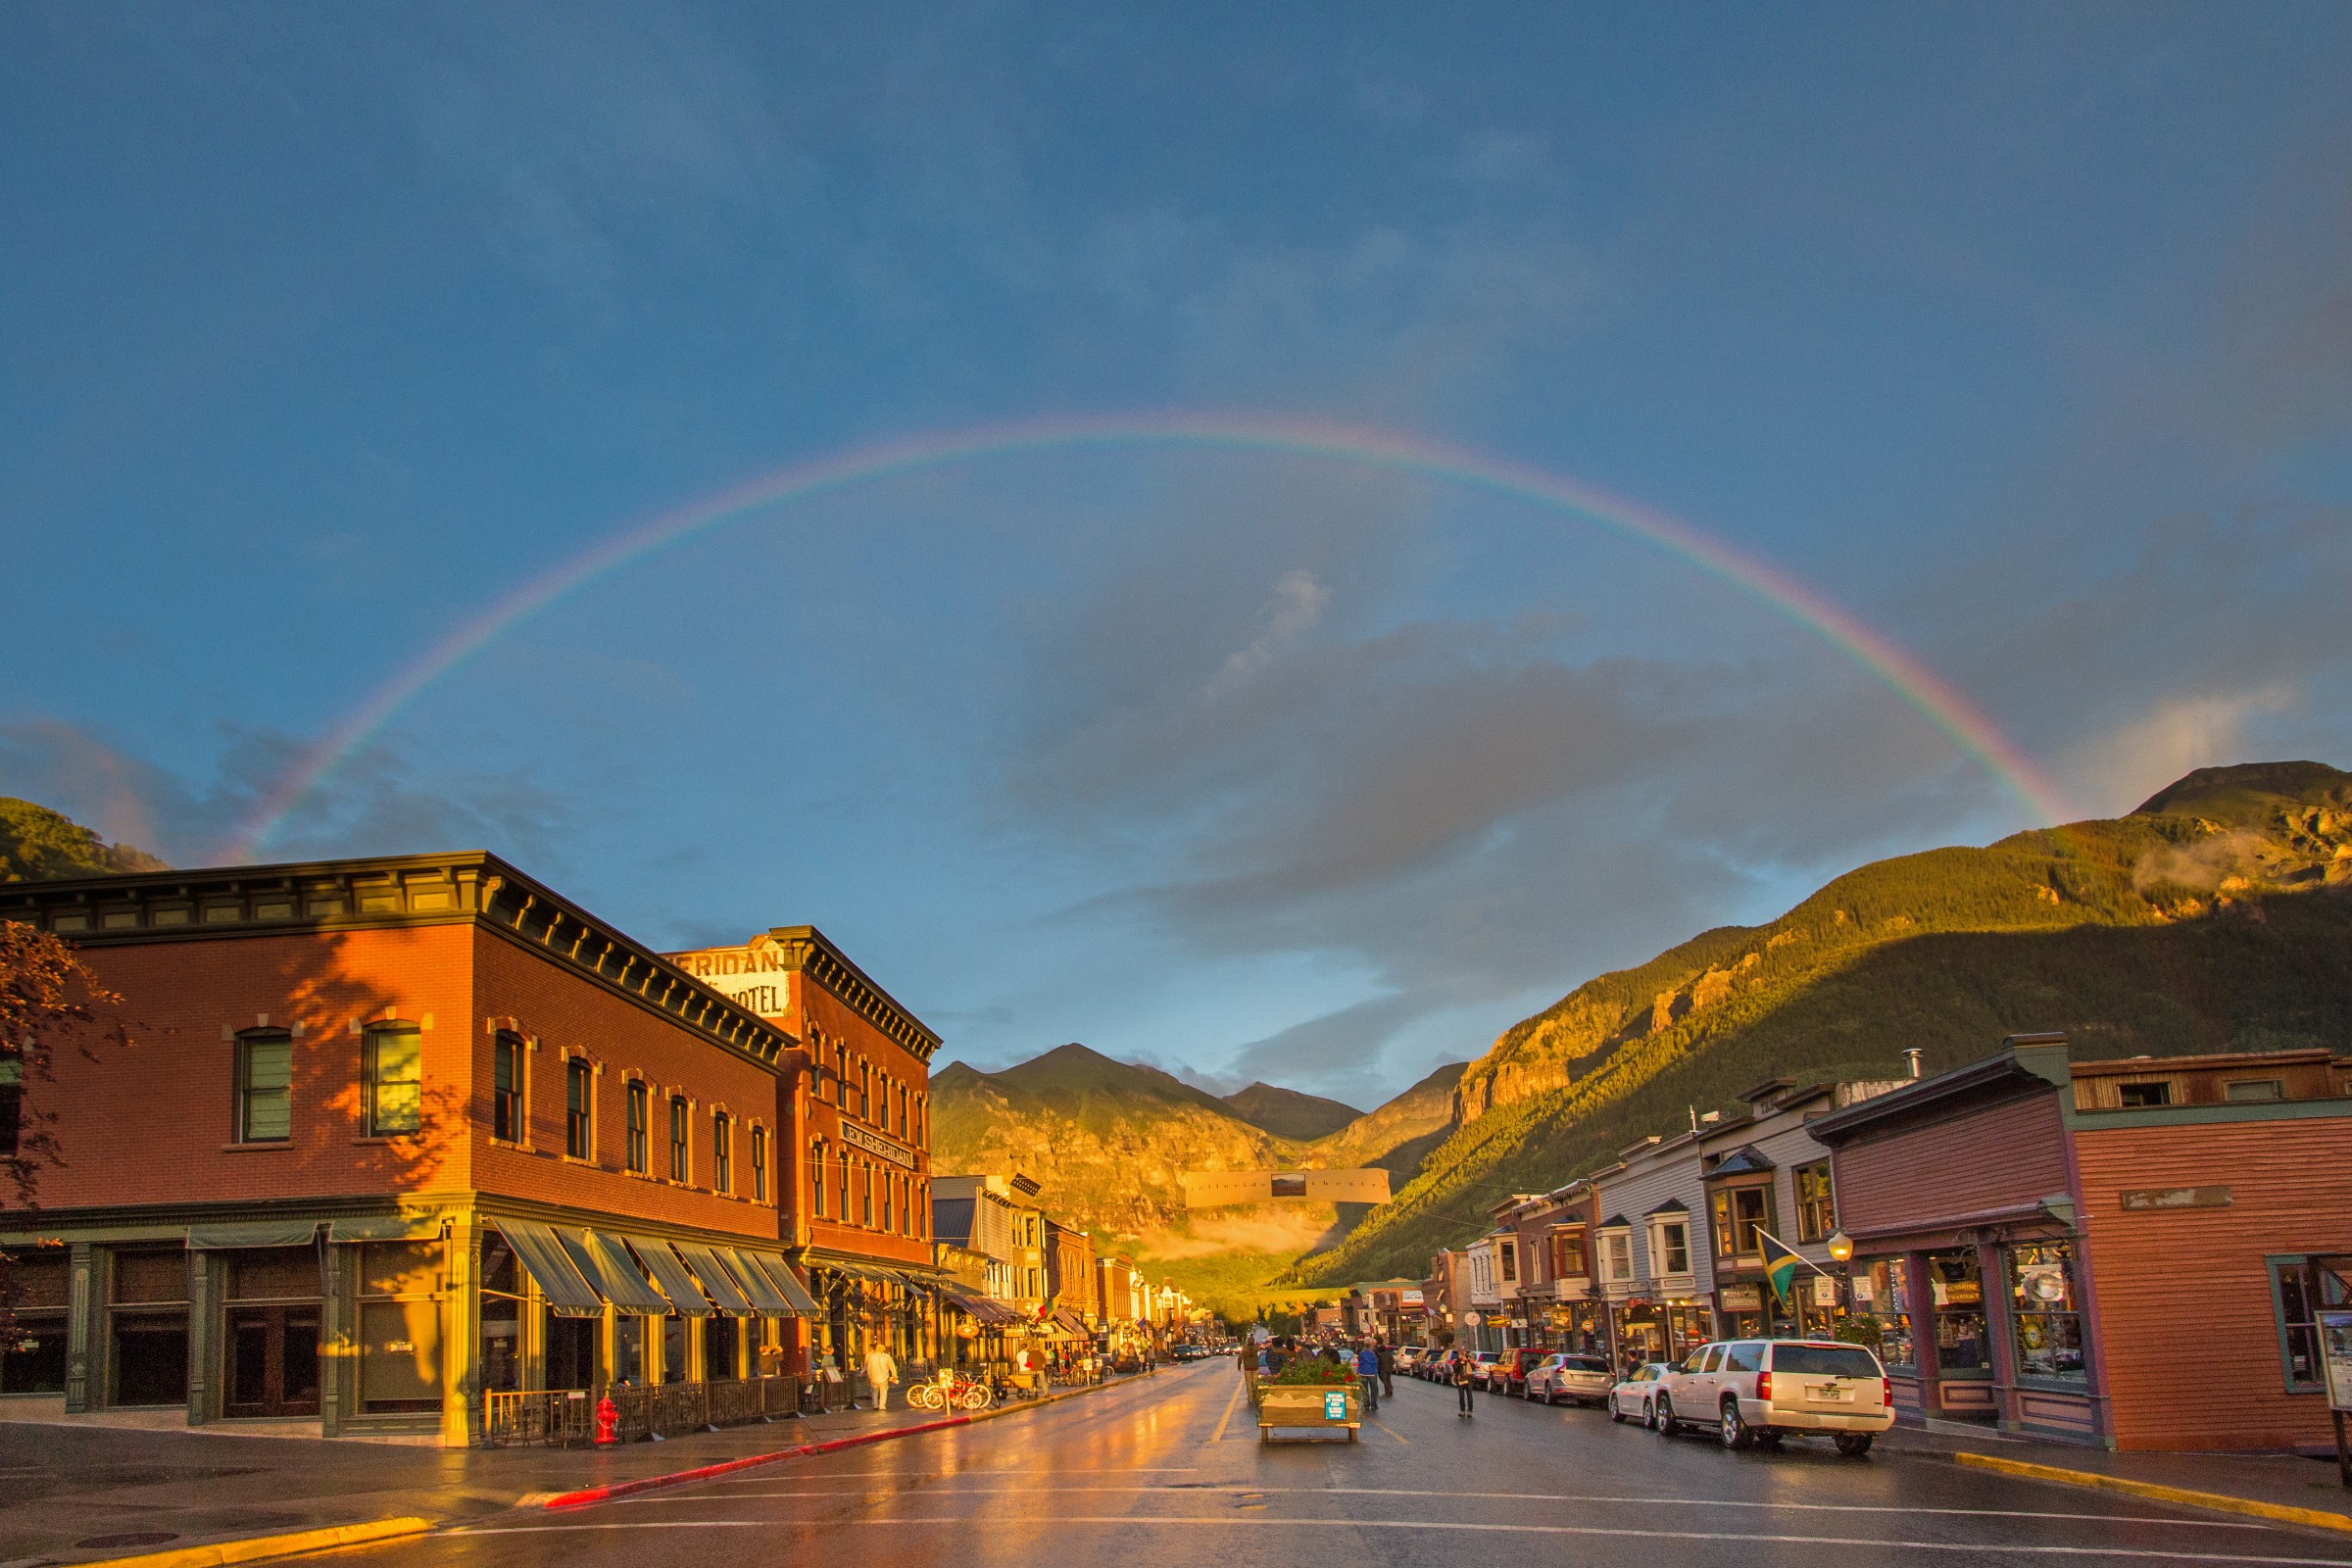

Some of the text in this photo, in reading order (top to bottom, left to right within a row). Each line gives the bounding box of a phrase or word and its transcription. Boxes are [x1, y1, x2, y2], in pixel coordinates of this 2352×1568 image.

[667, 951, 779, 977] ERIDAN
[725, 985, 782, 1013] OTEL
[864, 1134, 910, 1165] SHERIDAN
